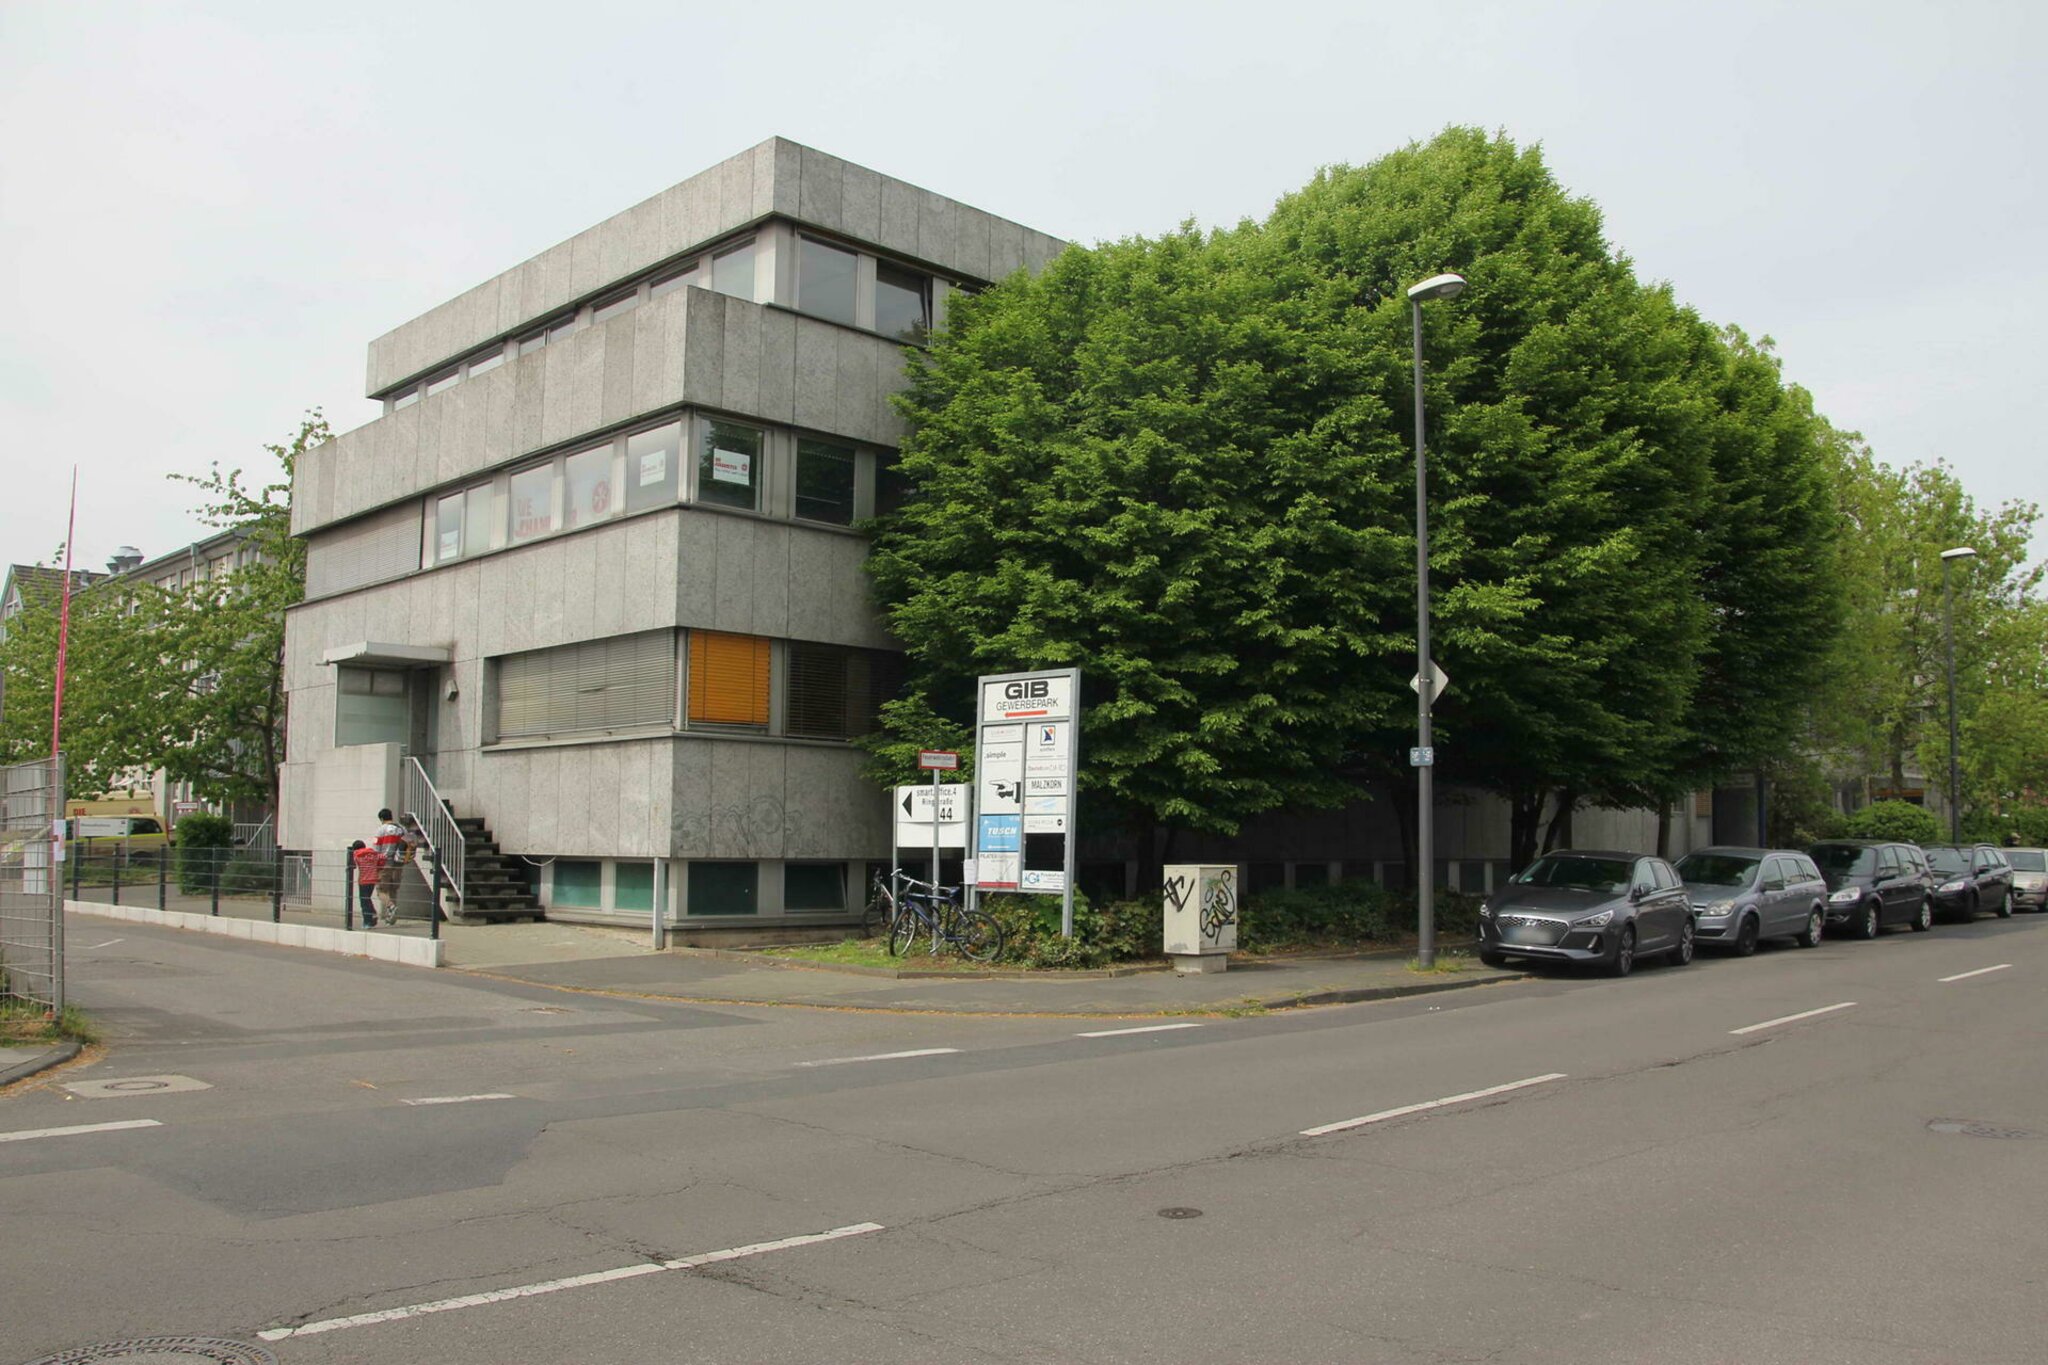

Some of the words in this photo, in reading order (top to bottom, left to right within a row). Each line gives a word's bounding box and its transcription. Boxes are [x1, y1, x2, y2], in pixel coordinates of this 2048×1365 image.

[1005, 680, 1049, 700] GIB
[996, 697, 1058, 711] GEWERBEPARK
[1031, 779, 1062, 790] MALZKORN
[939, 807, 953, 820] 44
